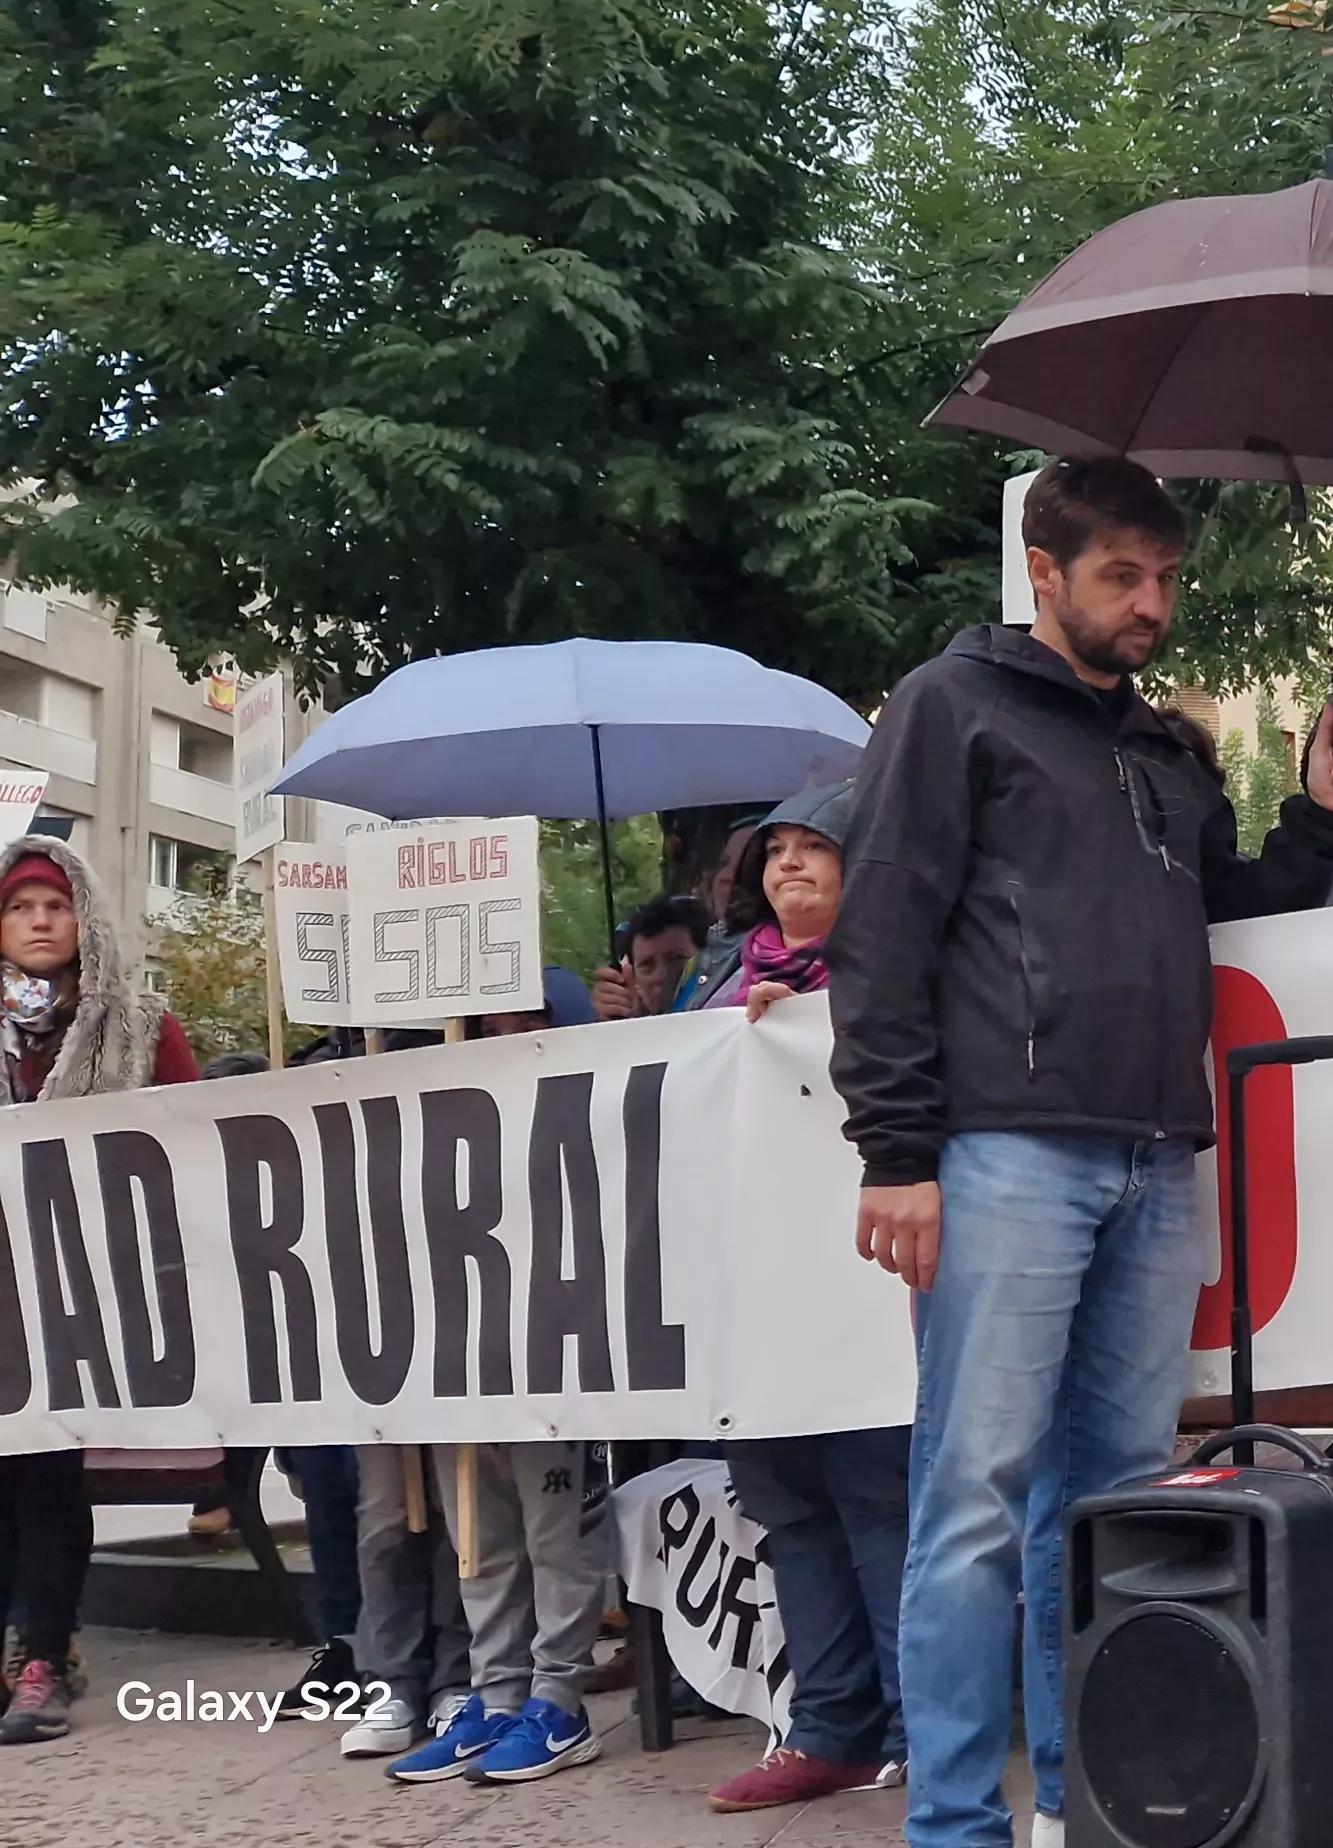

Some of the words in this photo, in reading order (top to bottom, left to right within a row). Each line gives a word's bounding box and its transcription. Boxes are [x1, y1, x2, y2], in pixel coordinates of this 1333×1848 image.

[0, 781, 43, 804] LLEGO
[397, 836, 508, 889] RIGLOS
[295, 912, 350, 1004] S
[373, 898, 522, 1003] SOS
[213, 1061, 686, 1406] RURAL
